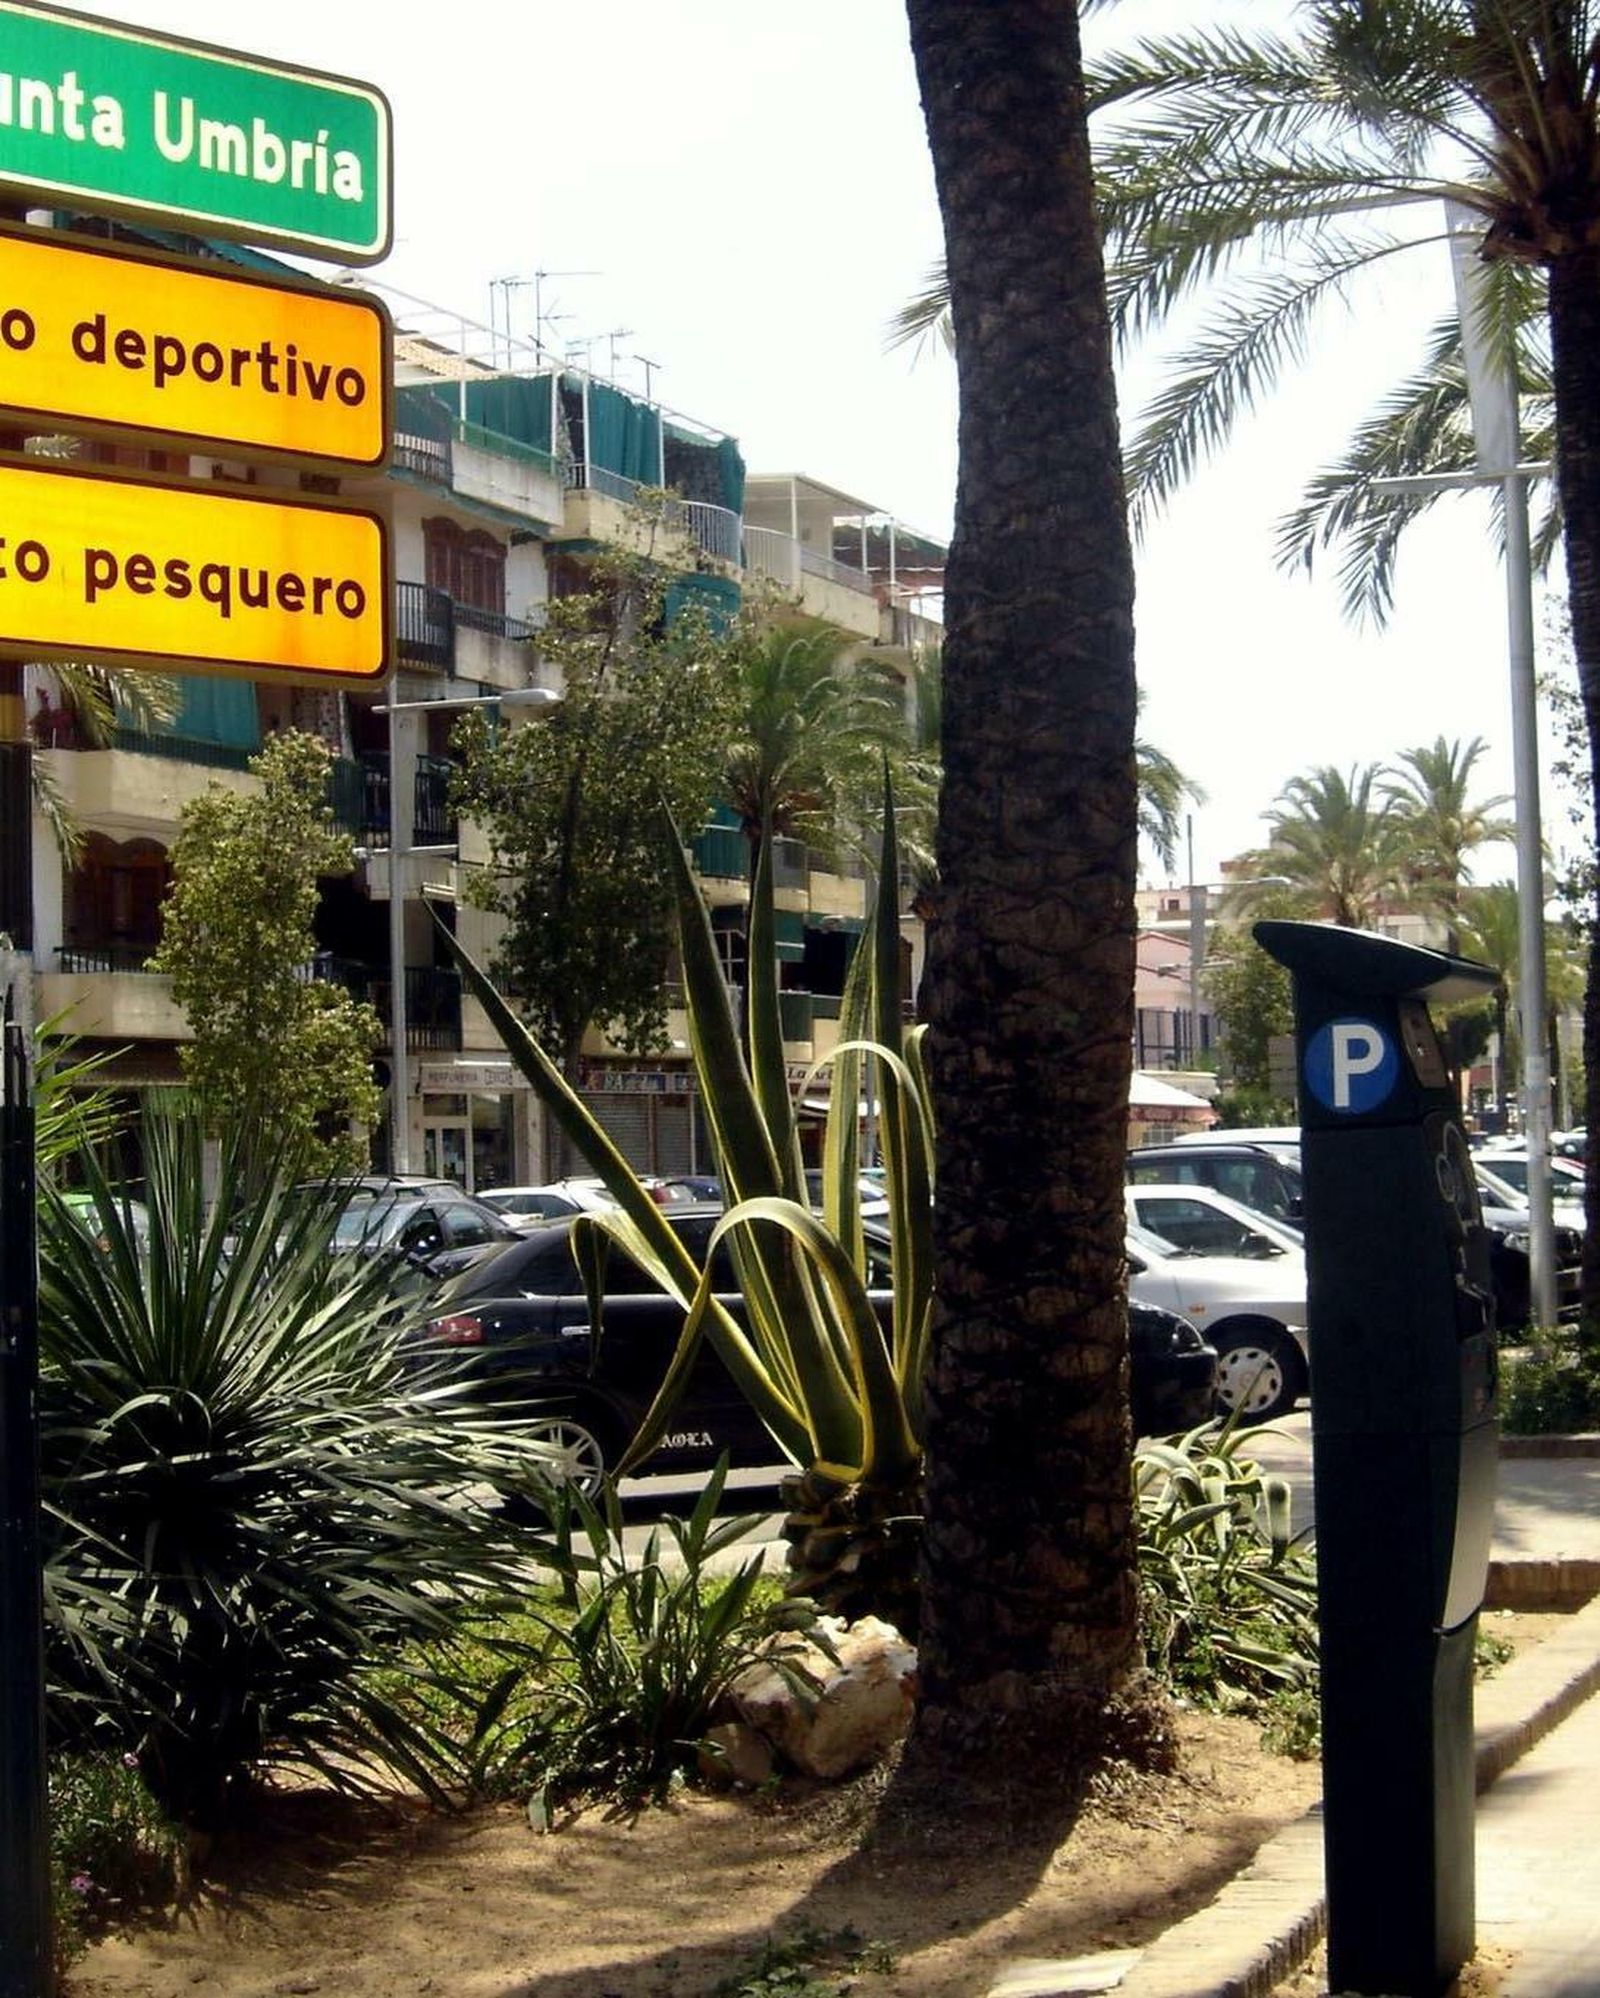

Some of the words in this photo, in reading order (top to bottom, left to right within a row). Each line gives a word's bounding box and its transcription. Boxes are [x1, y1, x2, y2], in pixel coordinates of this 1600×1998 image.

[153, 91, 364, 203] Umbría
[71, 314, 366, 407] deportivo
[0, 537, 50, 583] o
[85, 548, 366, 620] pesquero
[1332, 1024, 1384, 1107] P
